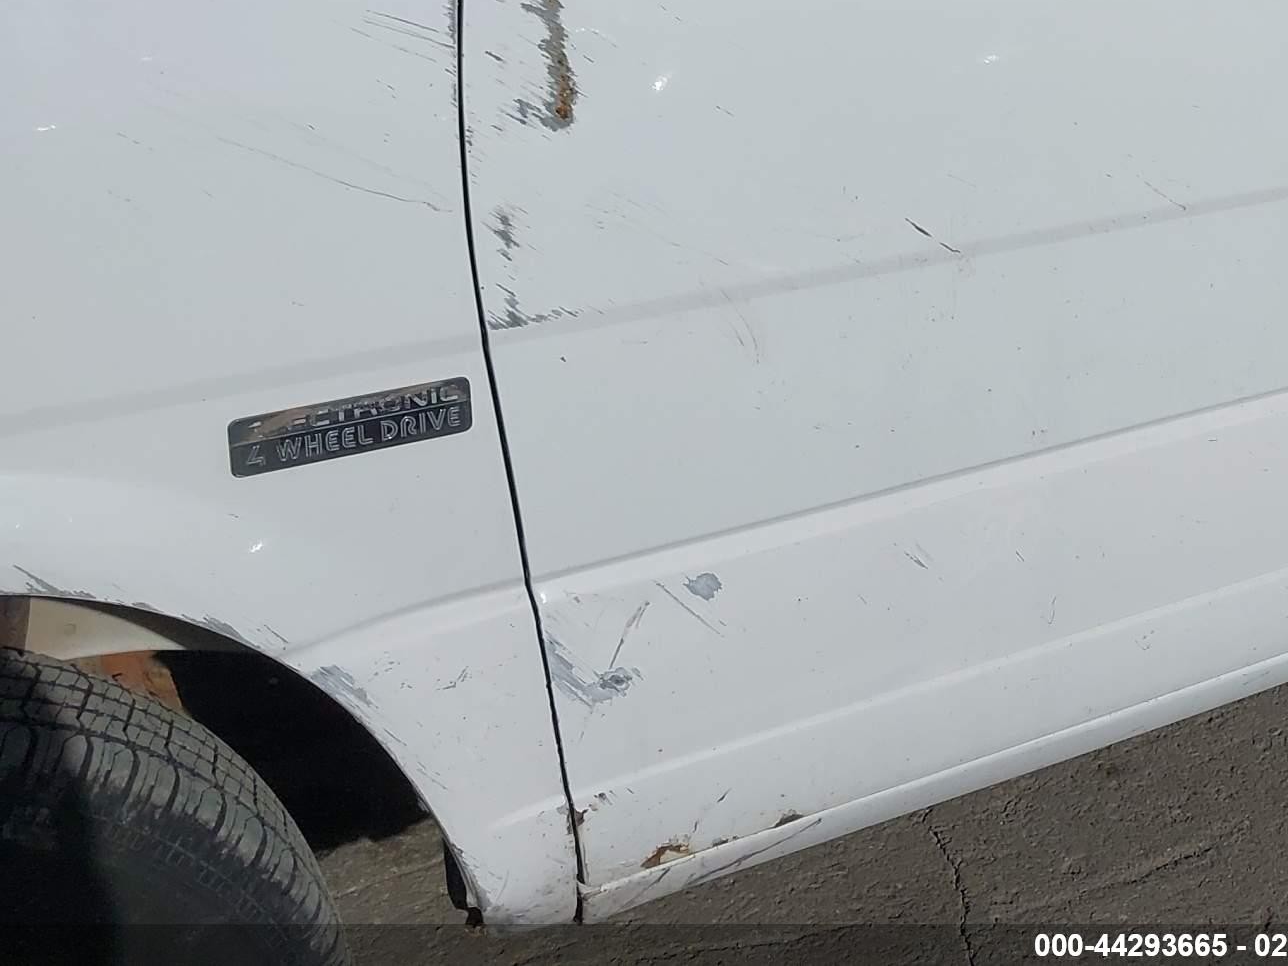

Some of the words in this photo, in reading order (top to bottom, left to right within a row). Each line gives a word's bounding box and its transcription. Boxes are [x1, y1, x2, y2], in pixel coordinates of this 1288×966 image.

[246, 444, 265, 465] 4
[276, 425, 374, 462] WHEEL
[380, 405, 461, 441] DRIVE
[248, 384, 460, 437] CTRONIC
